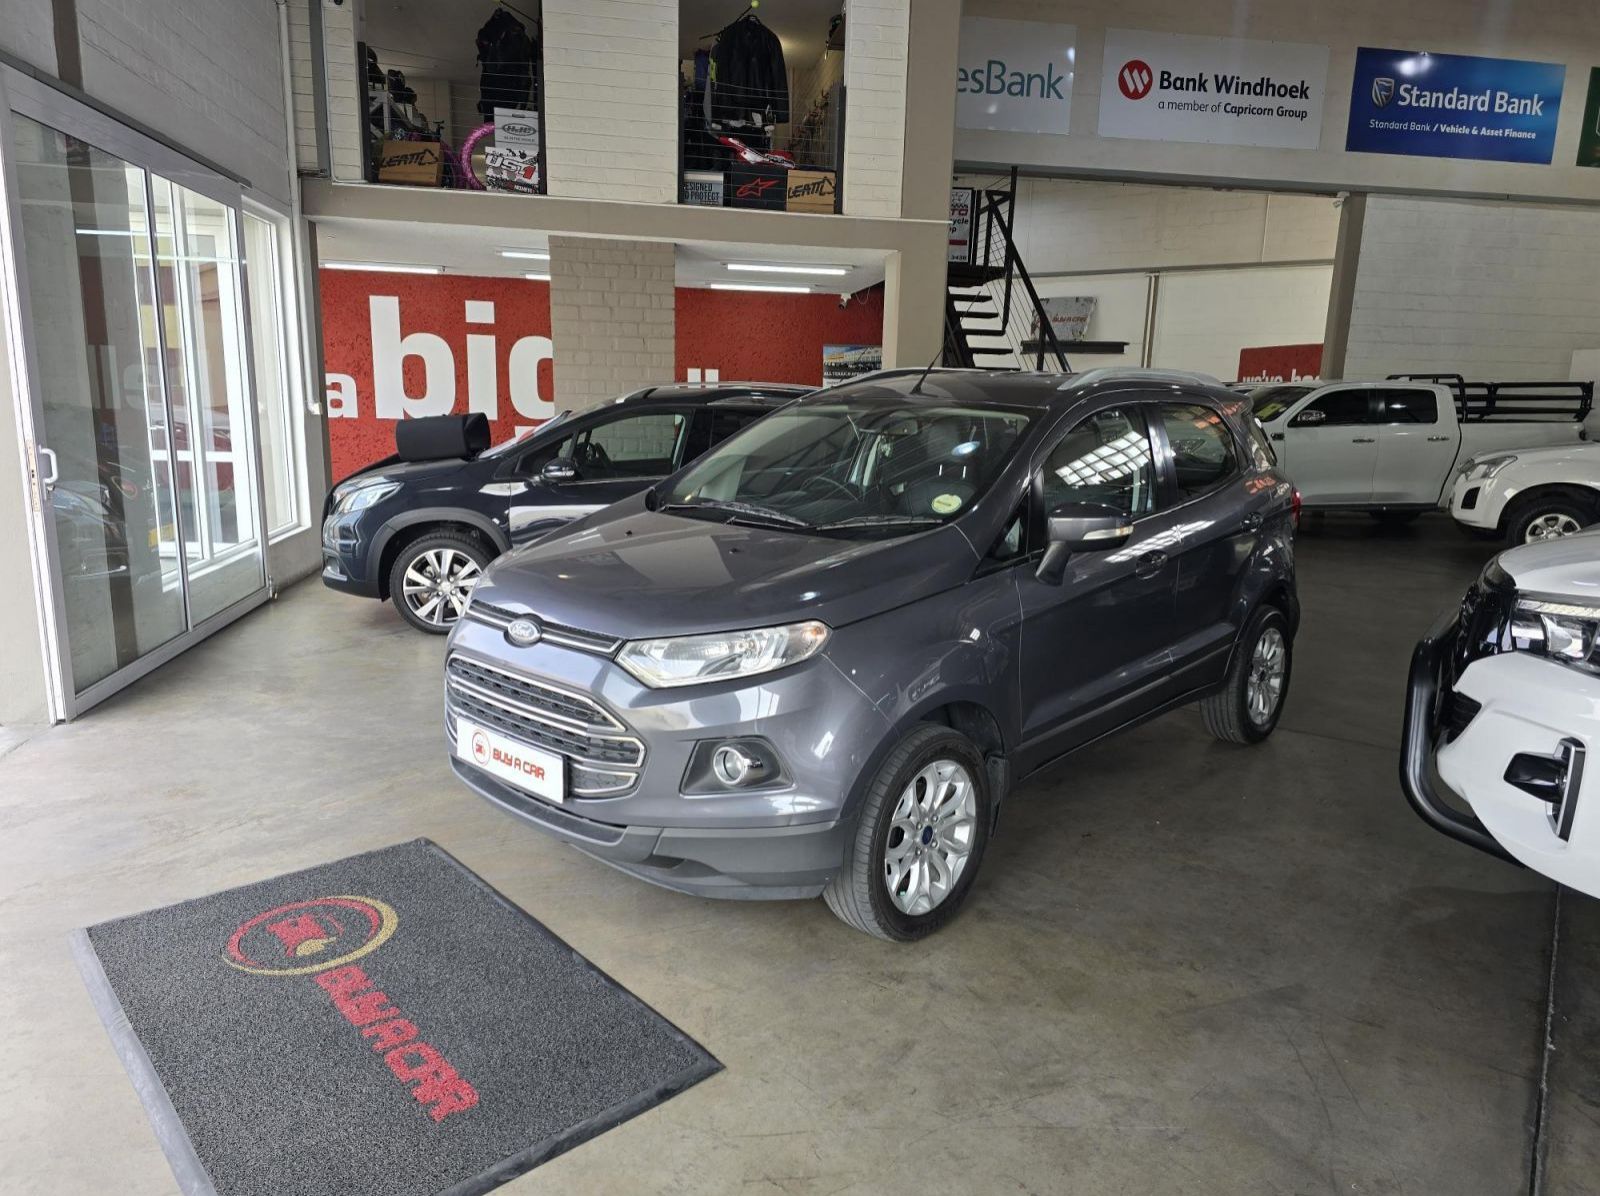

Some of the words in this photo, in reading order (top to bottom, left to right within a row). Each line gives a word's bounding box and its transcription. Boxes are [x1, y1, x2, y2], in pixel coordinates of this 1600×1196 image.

[1159, 70, 1208, 93] Bank
[1214, 74, 1310, 100] Windhoek
[1398, 83, 1490, 111] Standard
[1494, 91, 1544, 116] Bank
[1158, 101, 1165, 109] a
[1167, 101, 1209, 113] member
[1211, 102, 1222, 112] of
[1223, 103, 1273, 117] Capricorn
[1276, 106, 1308, 121] Group
[1369, 118, 1408, 130] Standard
[1409, 121, 1431, 132] Bank
[1440, 124, 1470, 134] Vehicle
[1471, 126, 1479, 135] &
[1480, 127, 1503, 137] Asset
[1504, 128, 1537, 140] Finance
[684, 182, 713, 192] ESIGNED
[690, 191, 720, 201] PROTECT
[325, 372, 358, 418] a
[493, 748, 513, 767] BUY
[514, 757, 522, 770] A
[523, 762, 545, 781] CAR
[314, 964, 401, 1026] BUY
[361, 1018, 421, 1053] A
[384, 1041, 480, 1123] CAR
